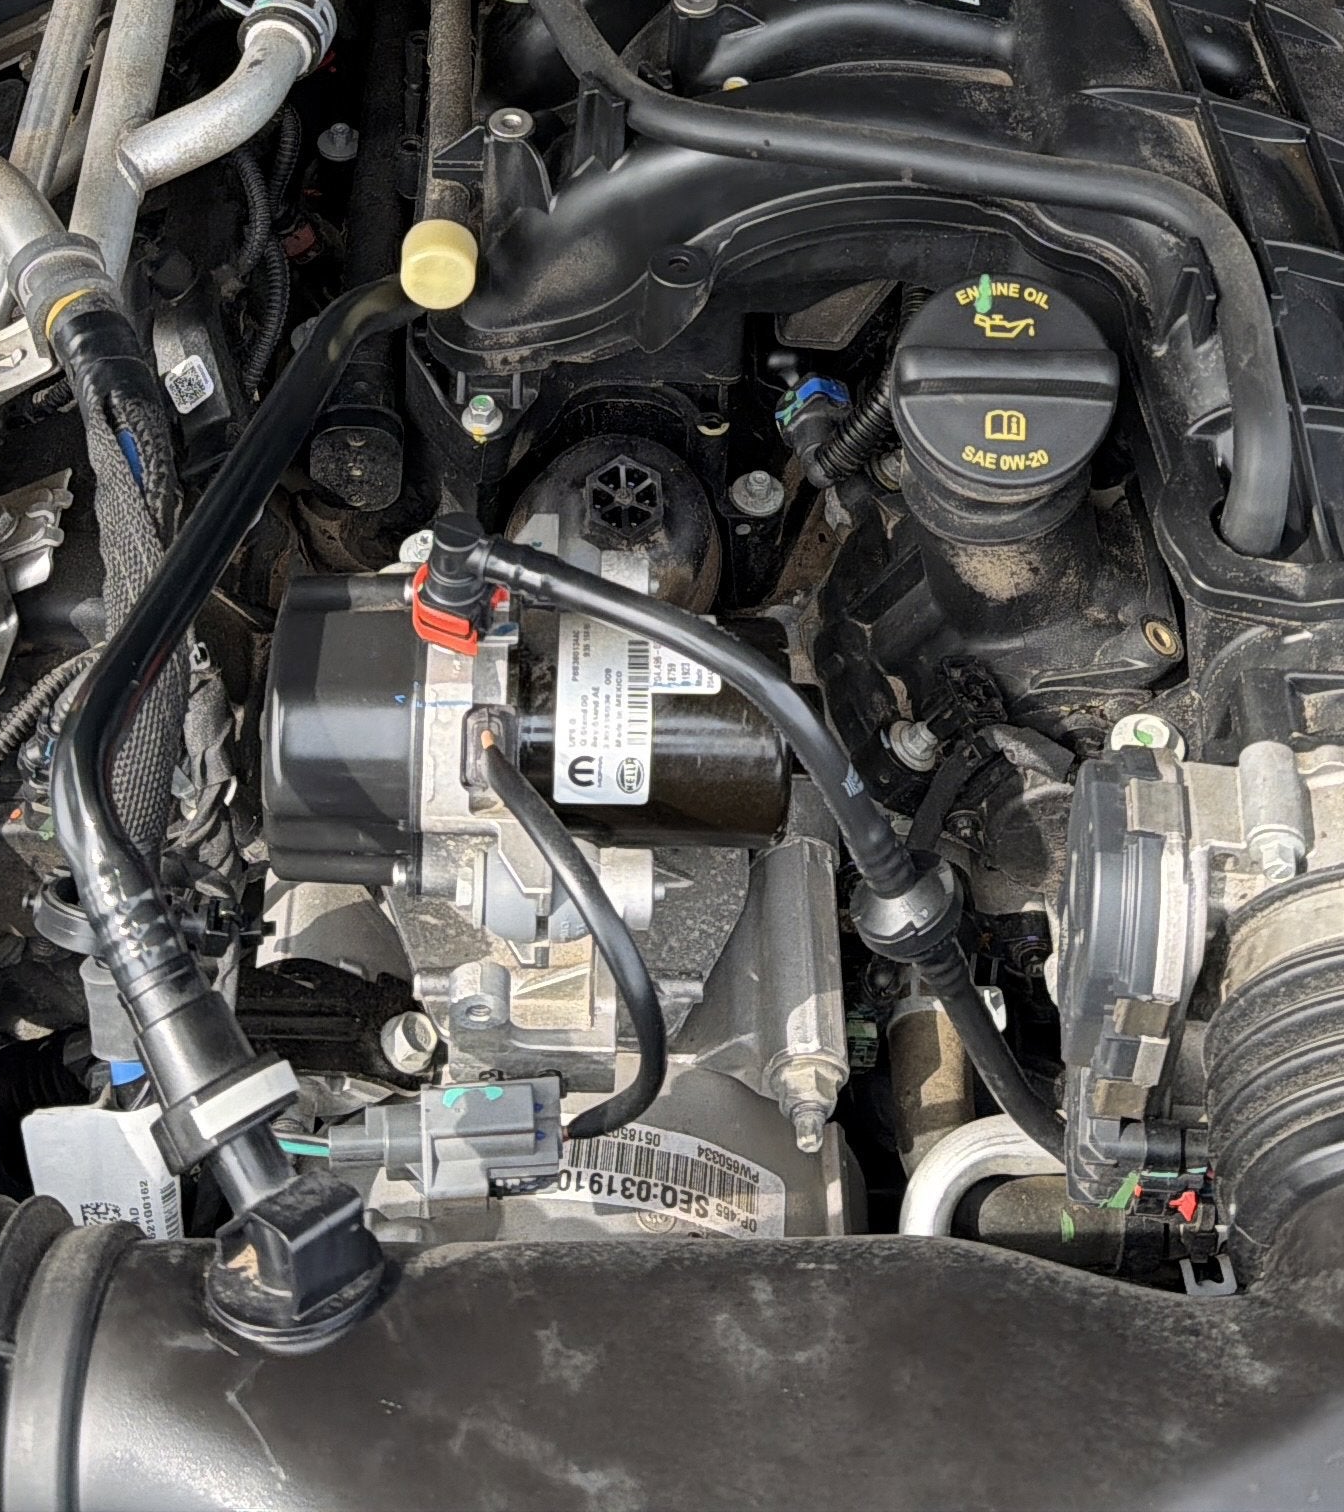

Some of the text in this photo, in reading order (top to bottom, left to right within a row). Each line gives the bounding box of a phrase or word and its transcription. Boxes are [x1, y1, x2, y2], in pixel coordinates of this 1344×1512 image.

[956, 282, 1050, 310] ENINE OIL
[961, 444, 1050, 471] SAE 0W-20
[615, 670, 623, 707] MEXICO
[624, 757, 637, 791] HELLA
[559, 1169, 710, 1219] SEQ:031910
